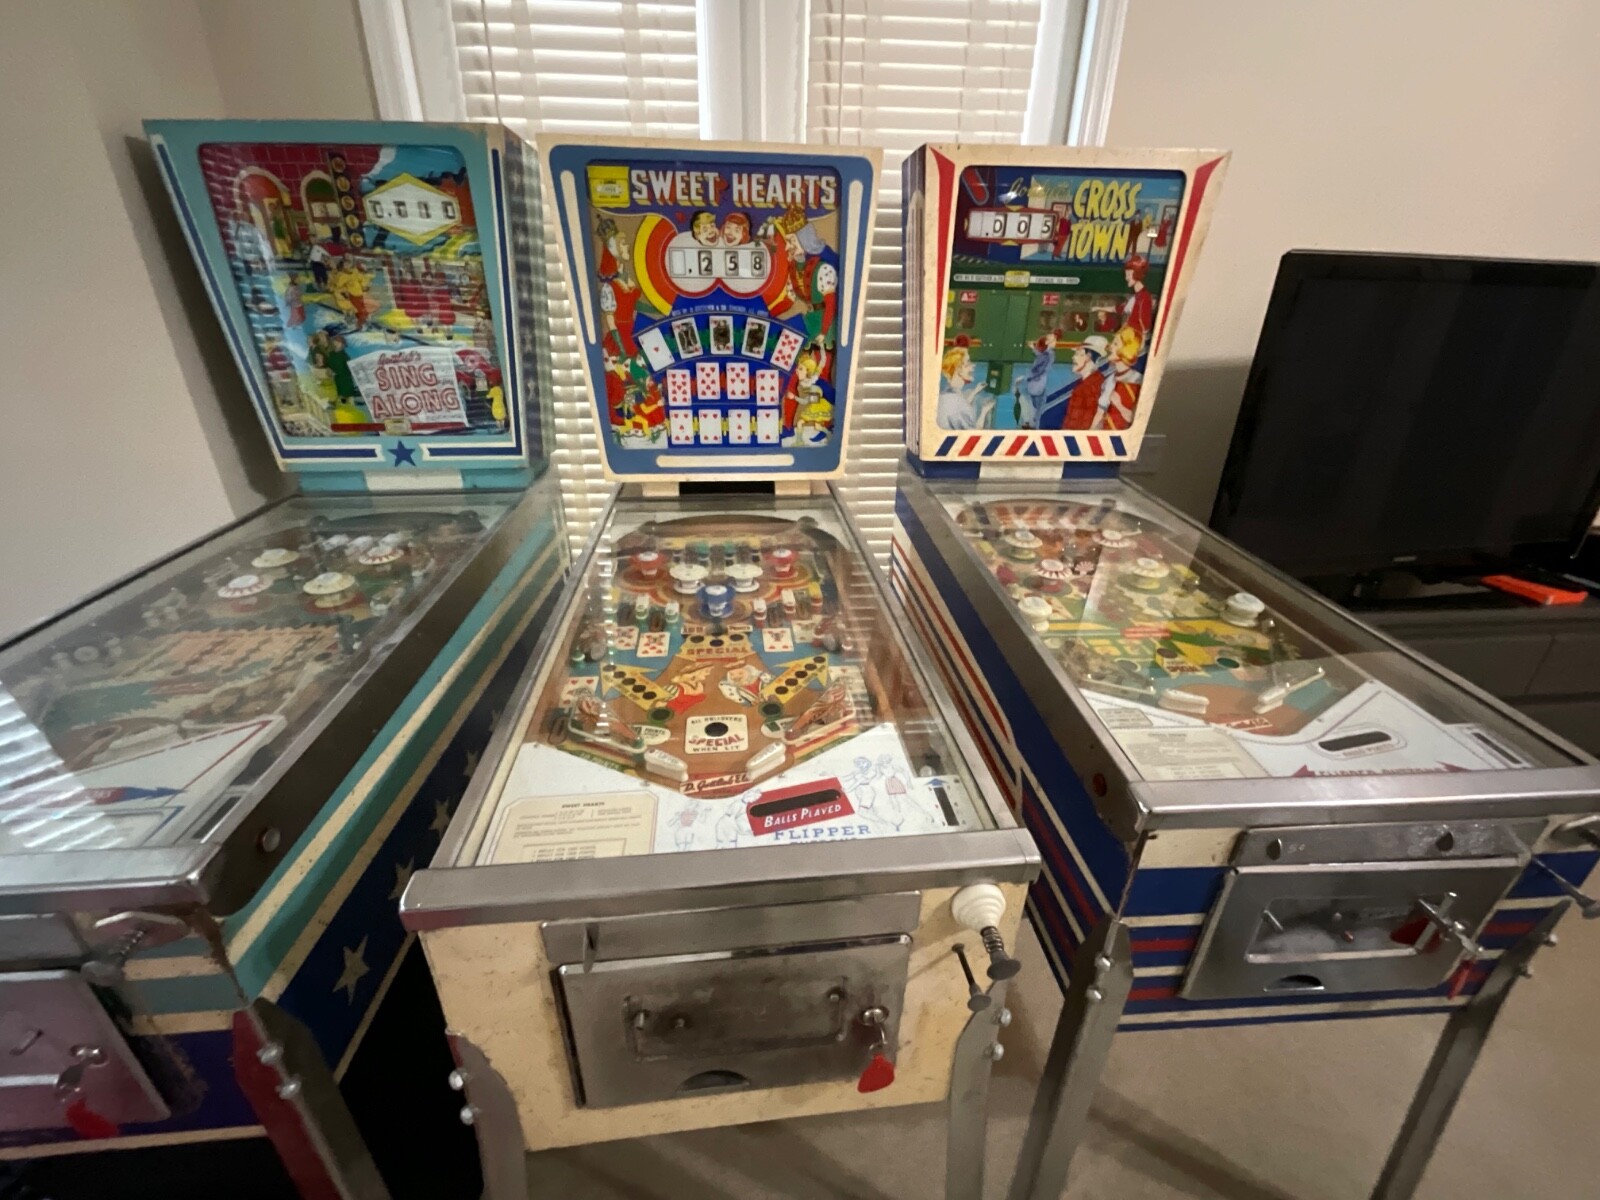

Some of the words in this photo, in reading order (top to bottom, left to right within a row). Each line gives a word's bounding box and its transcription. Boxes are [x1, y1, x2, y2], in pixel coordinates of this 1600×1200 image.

[631, 169, 720, 205] SWEET
[732, 173, 838, 209] HEARTS
[1073, 179, 1142, 220] CROSS
[1067, 222, 1131, 260] TOWN
[376, 363, 437, 391] SING
[373, 388, 460, 419] ALONG
[688, 734, 745, 747] SPECIAL
[764, 814, 798, 828] BALLS
[800, 804, 842, 820] PLAYED
[774, 825, 871, 841] FLIPPER
